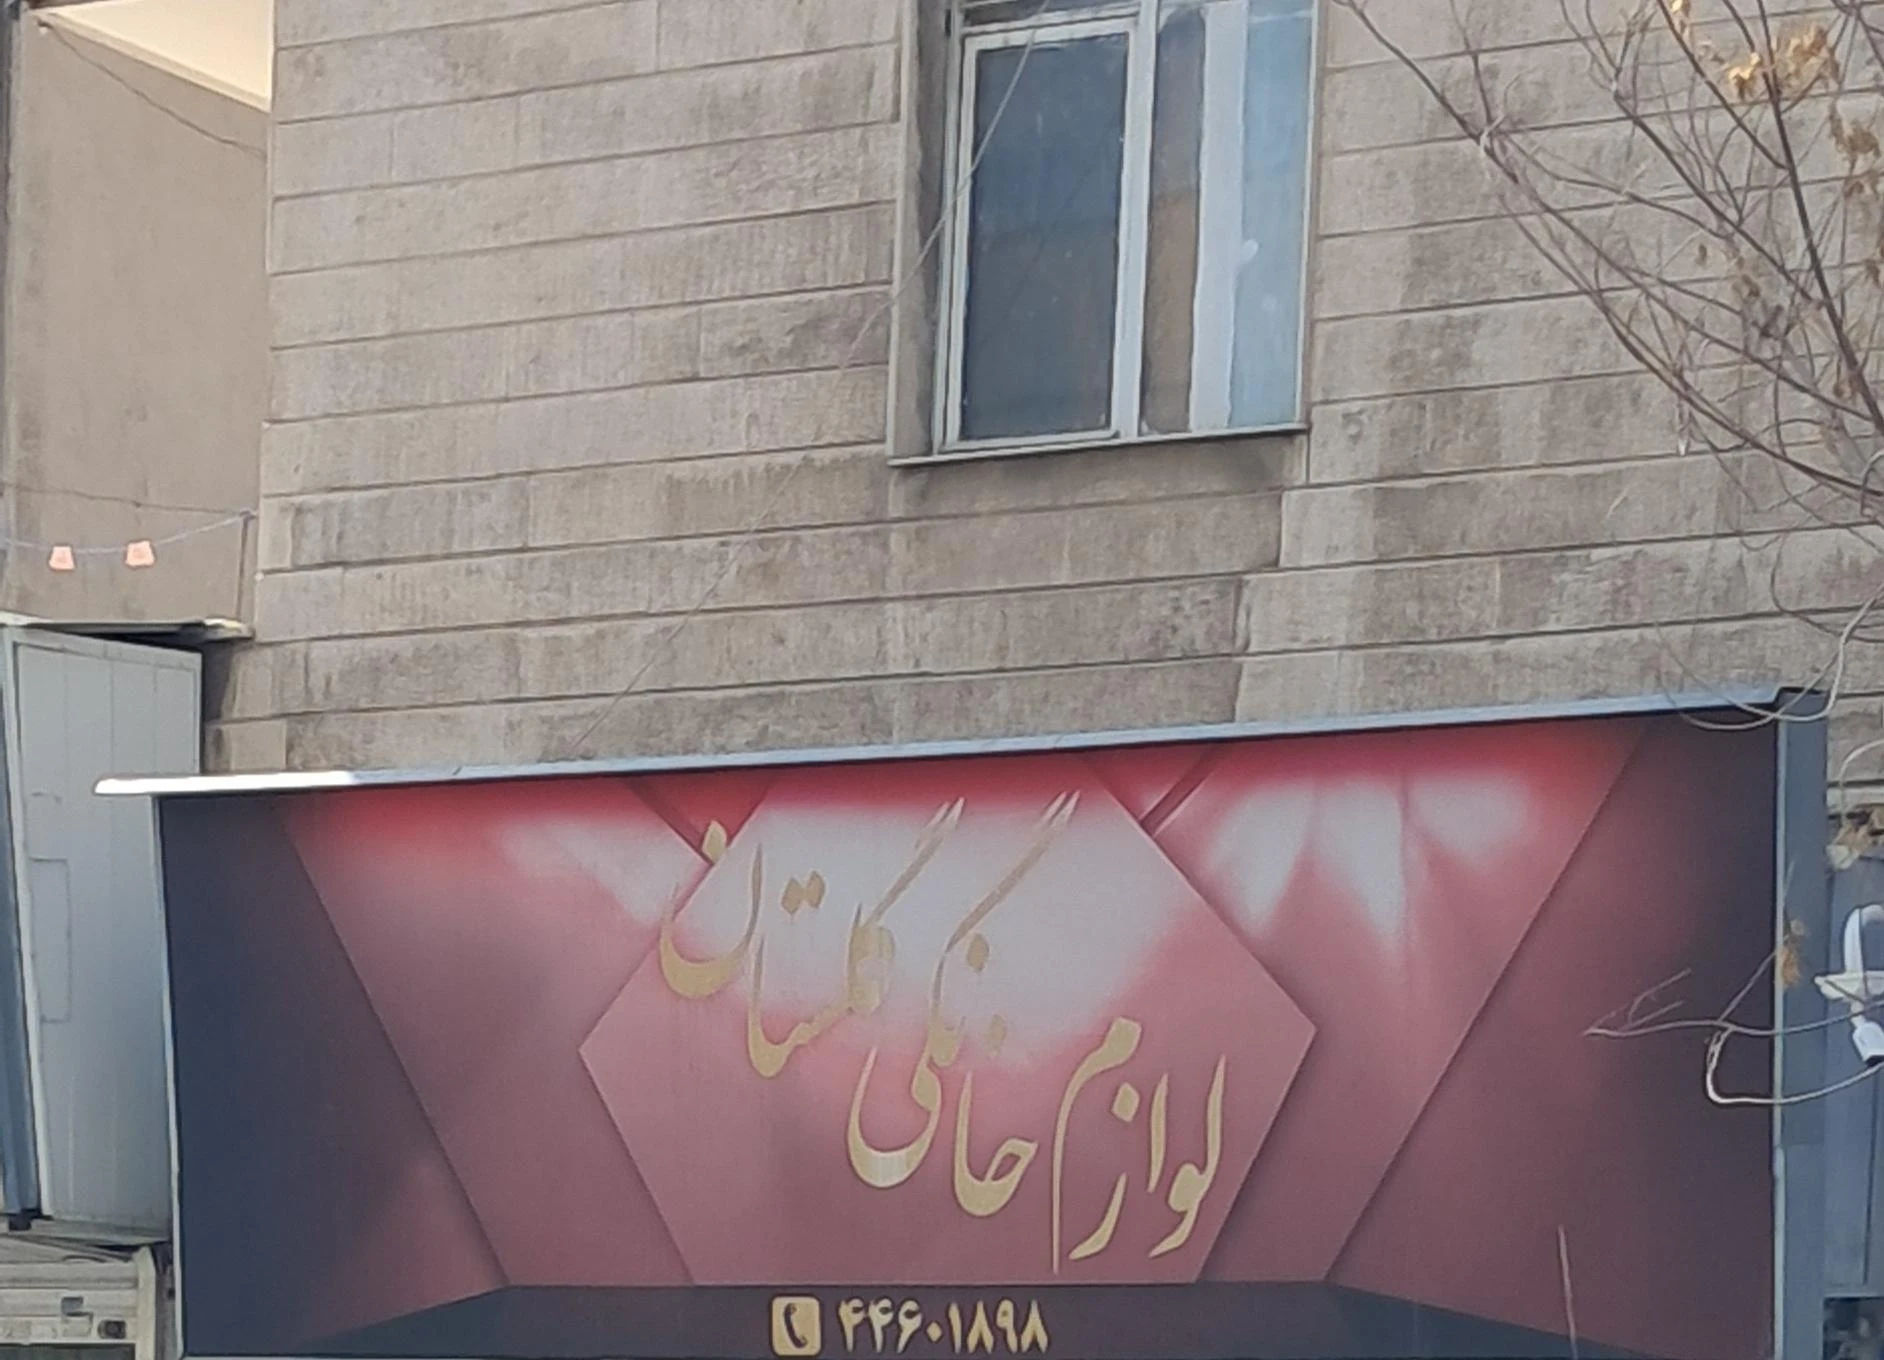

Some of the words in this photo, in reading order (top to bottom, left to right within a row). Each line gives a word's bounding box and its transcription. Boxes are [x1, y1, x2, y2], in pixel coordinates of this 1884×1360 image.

[659, 798, 966, 1079] گلستان
[847, 788, 1082, 1218] خانگی
[1048, 1016, 1228, 1275] لوازم
[837, 1298, 1049, 1354] ۴۴۶۰۱۸۹۸
